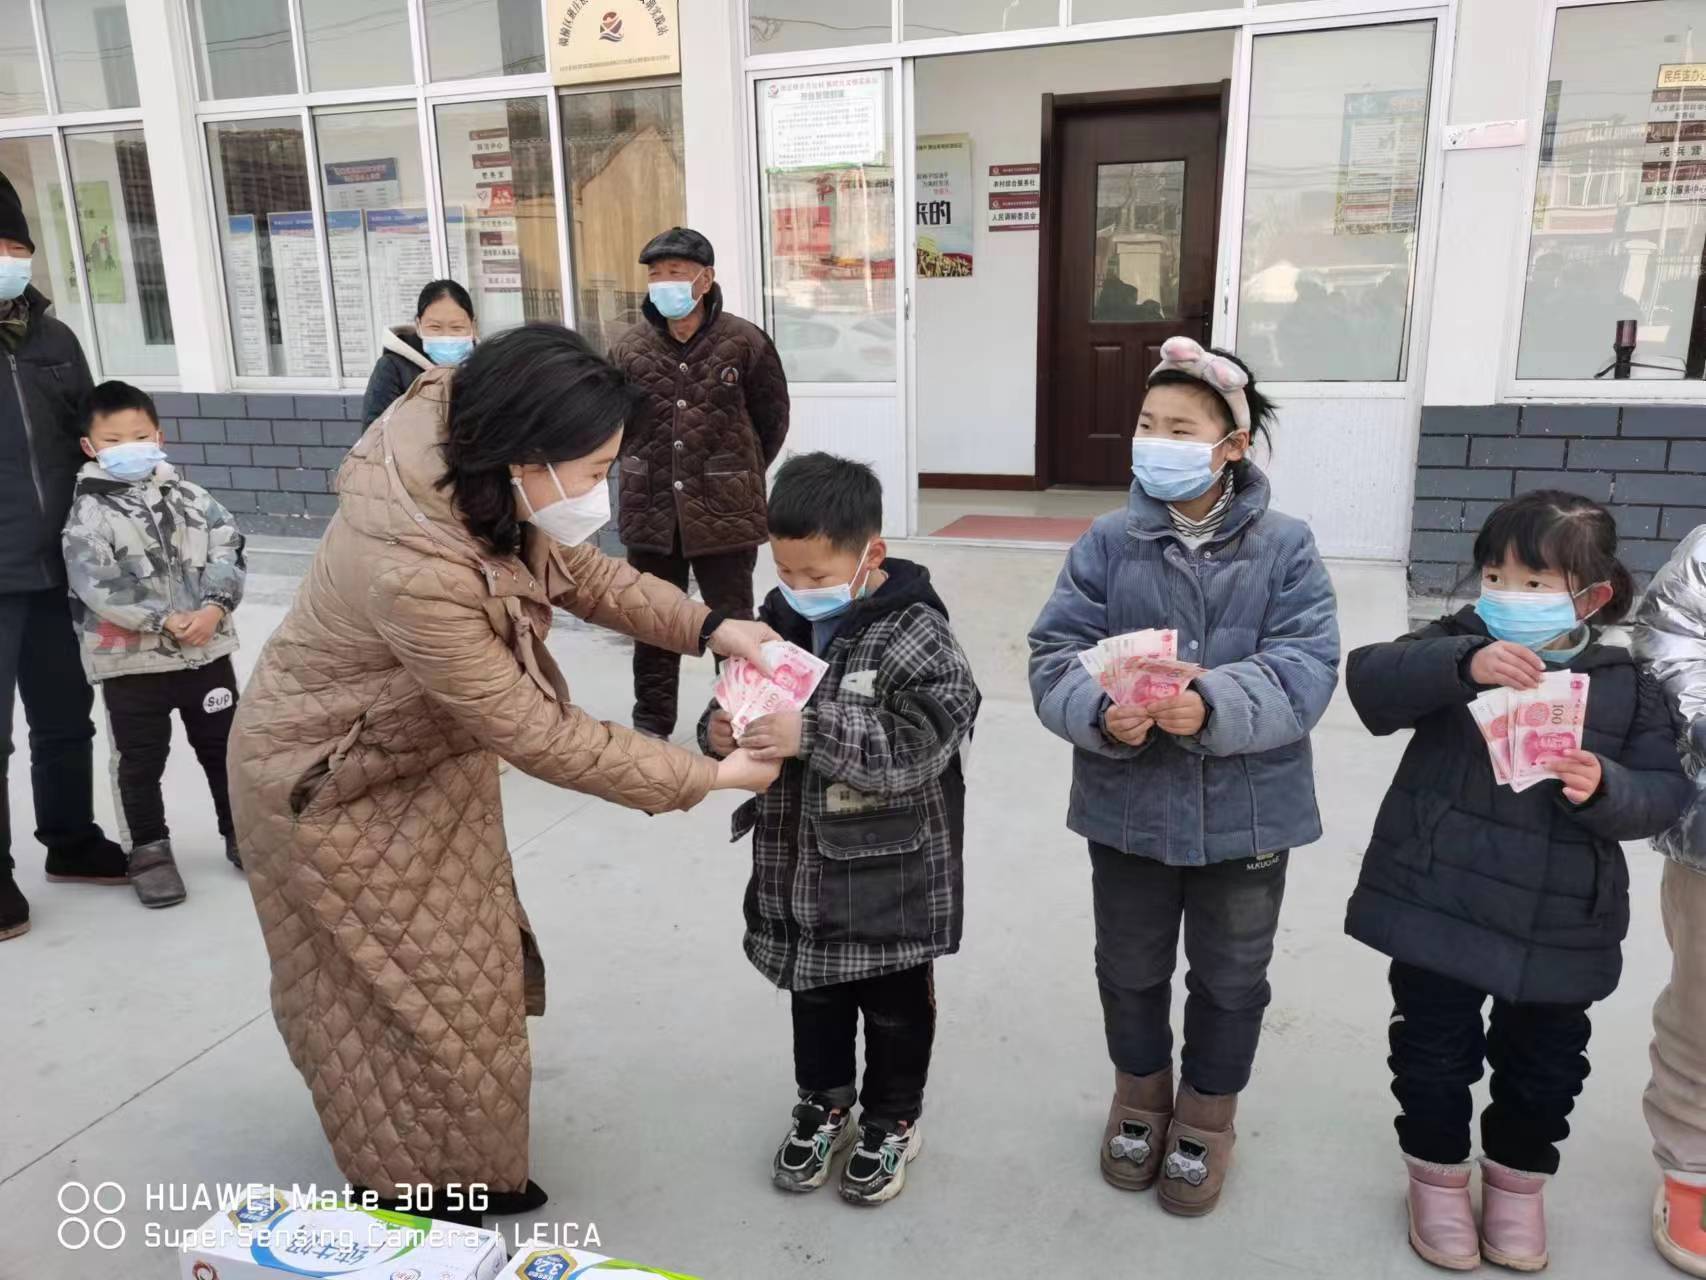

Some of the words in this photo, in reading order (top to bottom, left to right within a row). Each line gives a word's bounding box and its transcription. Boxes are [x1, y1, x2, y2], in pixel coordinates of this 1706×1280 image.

[992, 212, 1037, 221] 人民调解委员会
